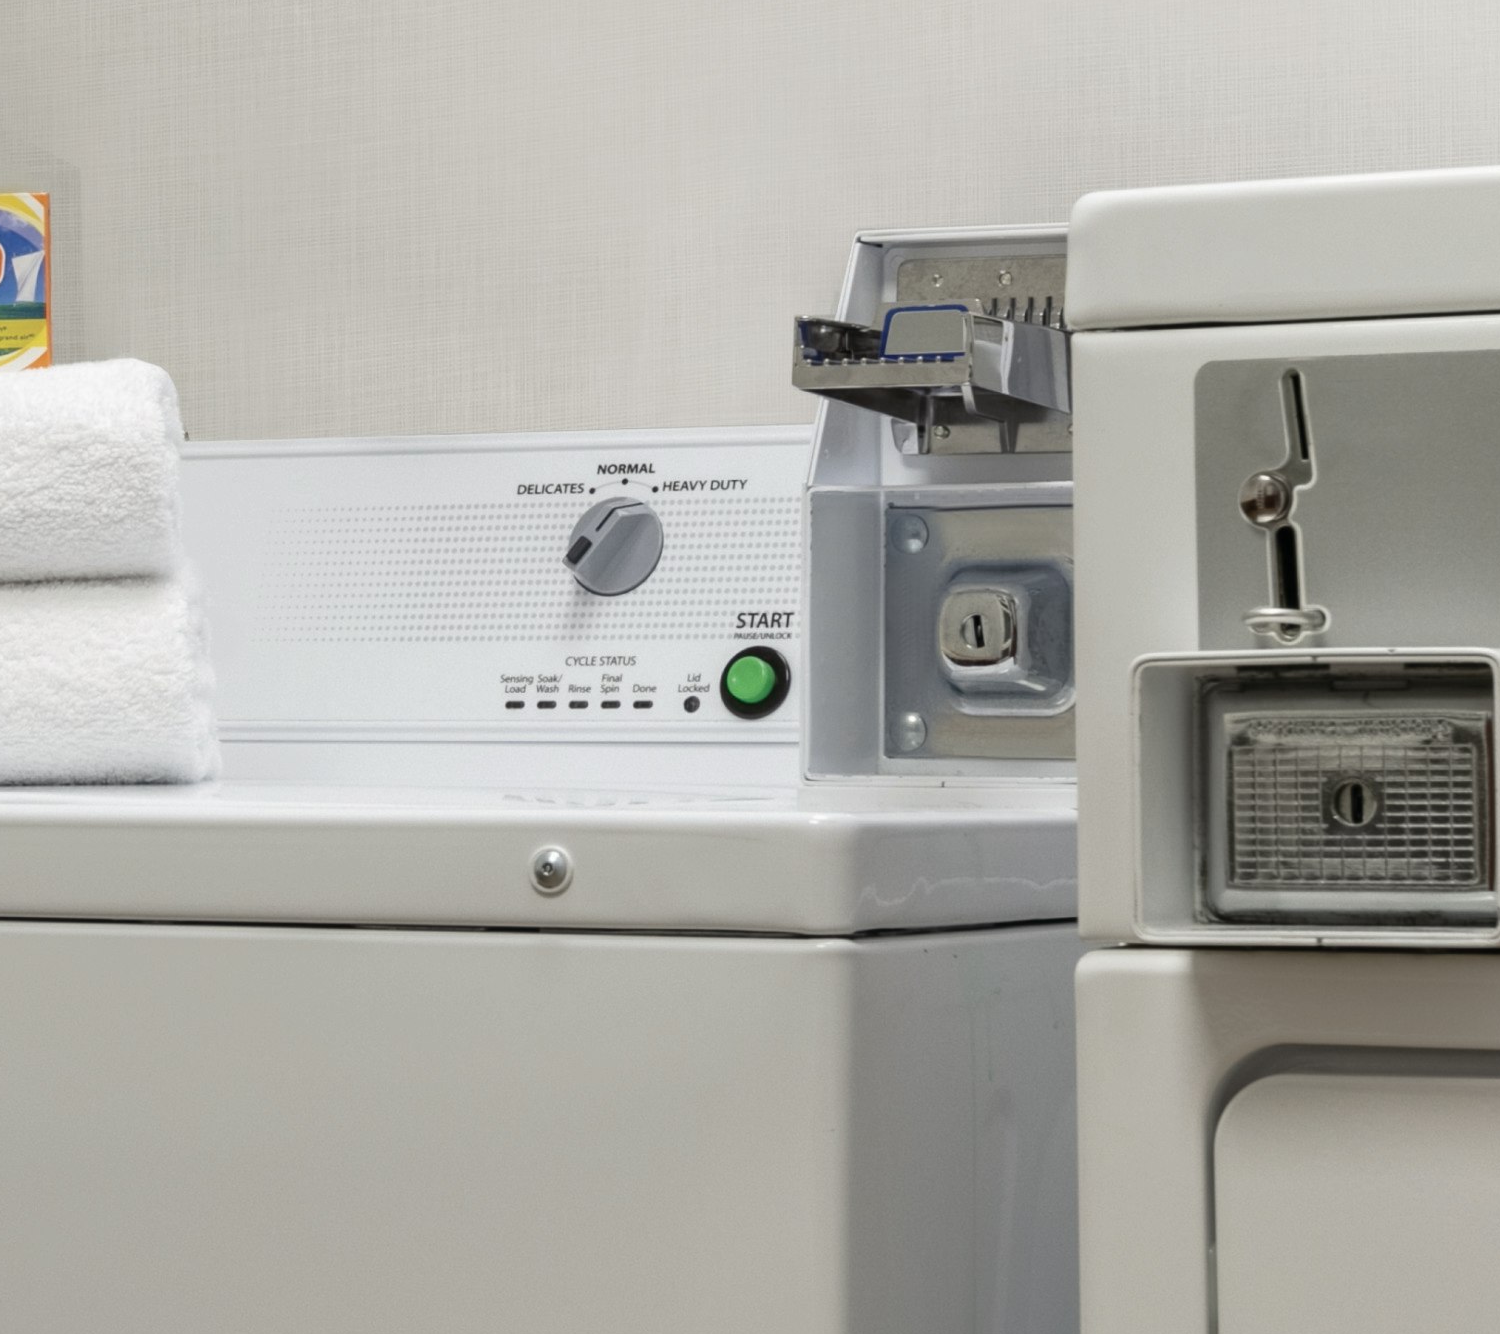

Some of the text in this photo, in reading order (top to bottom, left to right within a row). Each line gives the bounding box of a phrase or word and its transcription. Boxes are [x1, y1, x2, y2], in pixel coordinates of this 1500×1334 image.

[597, 463, 656, 475] NORMAL
[517, 483, 585, 495] DELICATES
[662, 479, 748, 492] HEAVY DUTY
[736, 611, 794, 629] START
[565, 655, 637, 667] CYCLE STATUS
[500, 674, 534, 685] Sensing
[537, 673, 563, 683] Soak/
[601, 673, 623, 683] Final
[687, 673, 701, 683] Lid
[504, 685, 526, 693] Load
[536, 684, 560, 693] Wash
[568, 684, 592, 693] Rinse
[600, 684, 620, 695] Spin
[632, 684, 657, 693] Done
[678, 683, 710, 693] Locked
